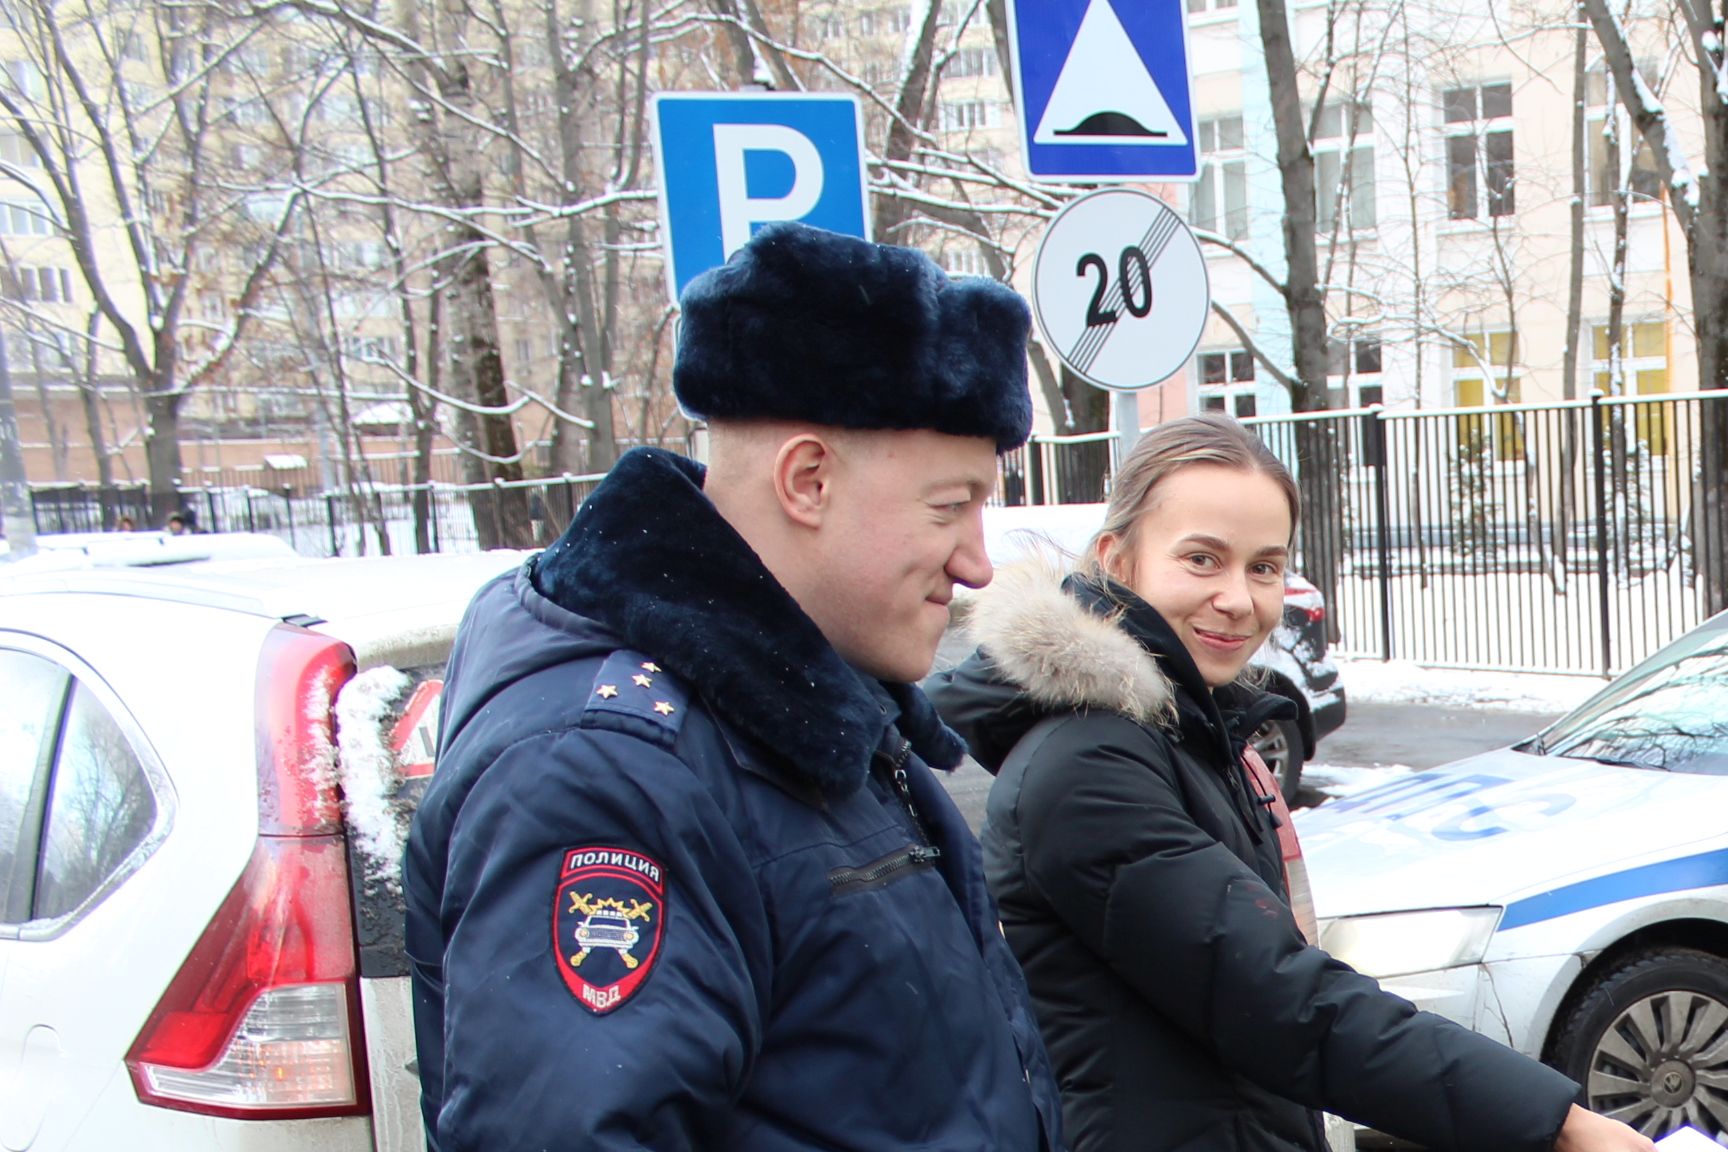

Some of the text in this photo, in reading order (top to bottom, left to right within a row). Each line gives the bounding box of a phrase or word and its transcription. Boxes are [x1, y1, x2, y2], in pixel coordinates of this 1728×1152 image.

[713, 124, 824, 265] P
[1076, 246, 1152, 328] 20
[570, 851, 660, 883] ПОЛИЦИЯ
[582, 983, 622, 1009] МВД
